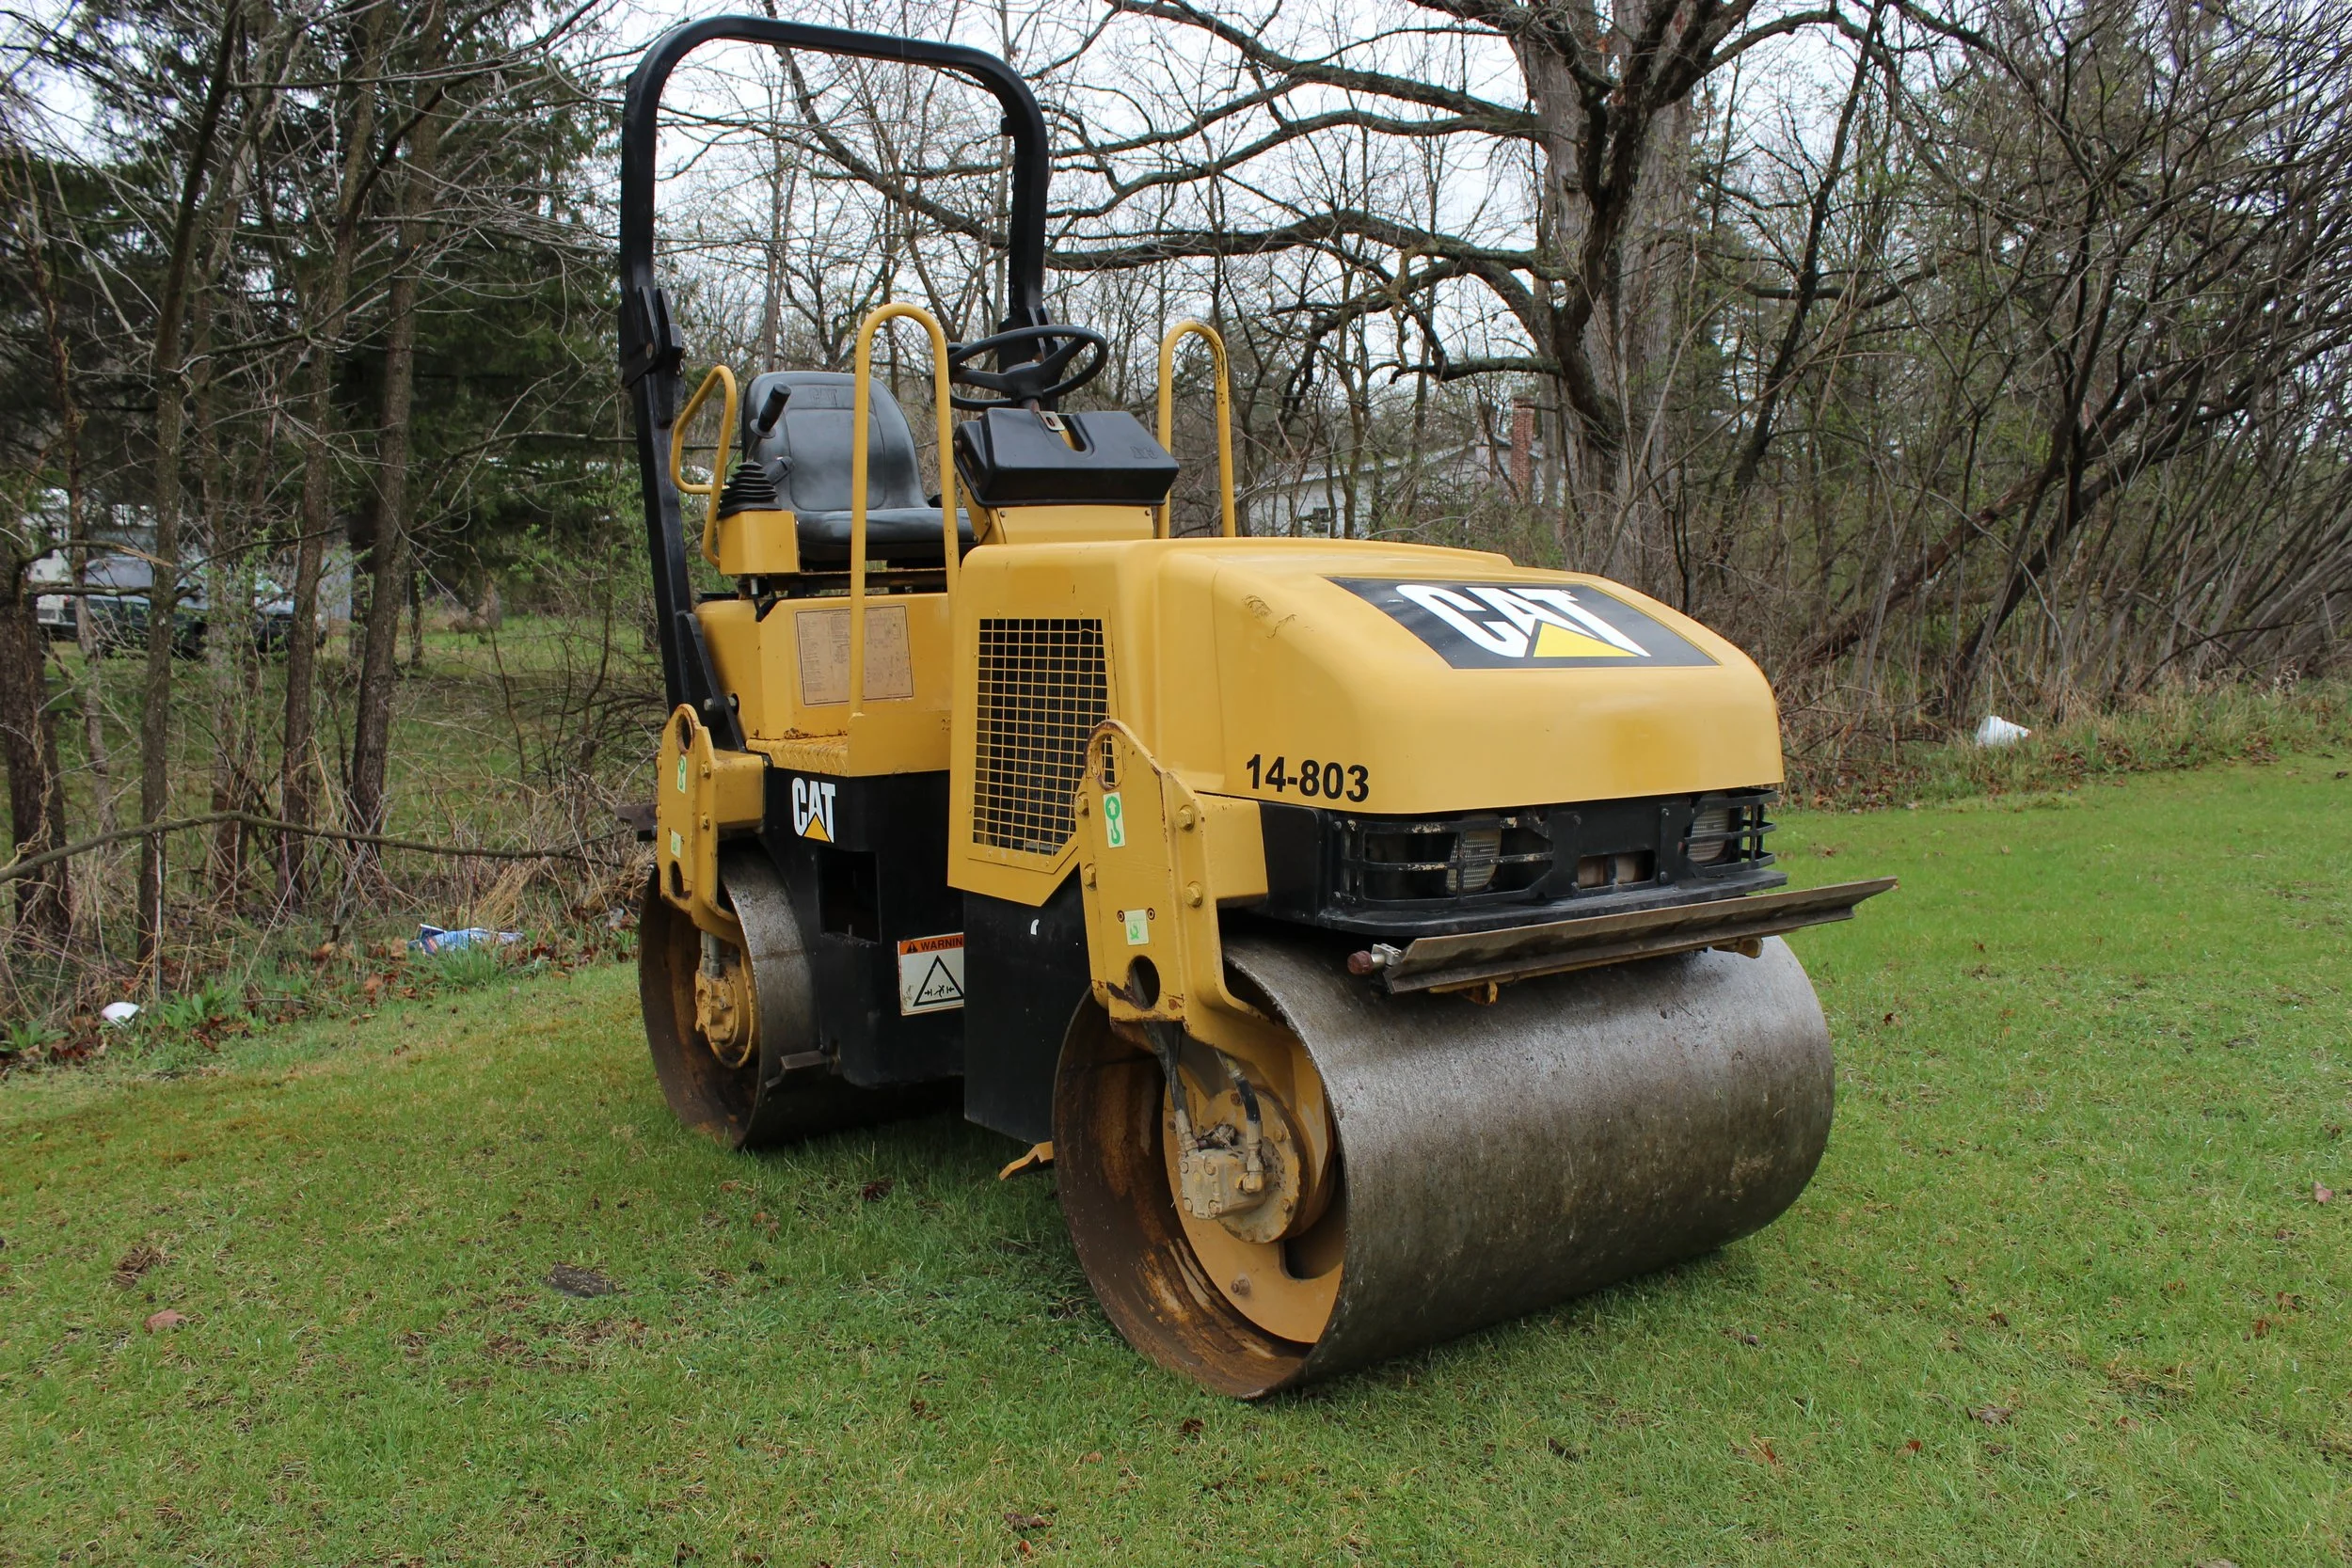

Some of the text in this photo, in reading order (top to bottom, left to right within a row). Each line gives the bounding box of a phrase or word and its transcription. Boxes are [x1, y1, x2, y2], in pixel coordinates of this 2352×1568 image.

[1396, 584, 1651, 658] CAT
[1246, 753, 1370, 803] 14-803
[791, 777, 836, 844] CAT
[920, 937, 963, 951] WARNIN
